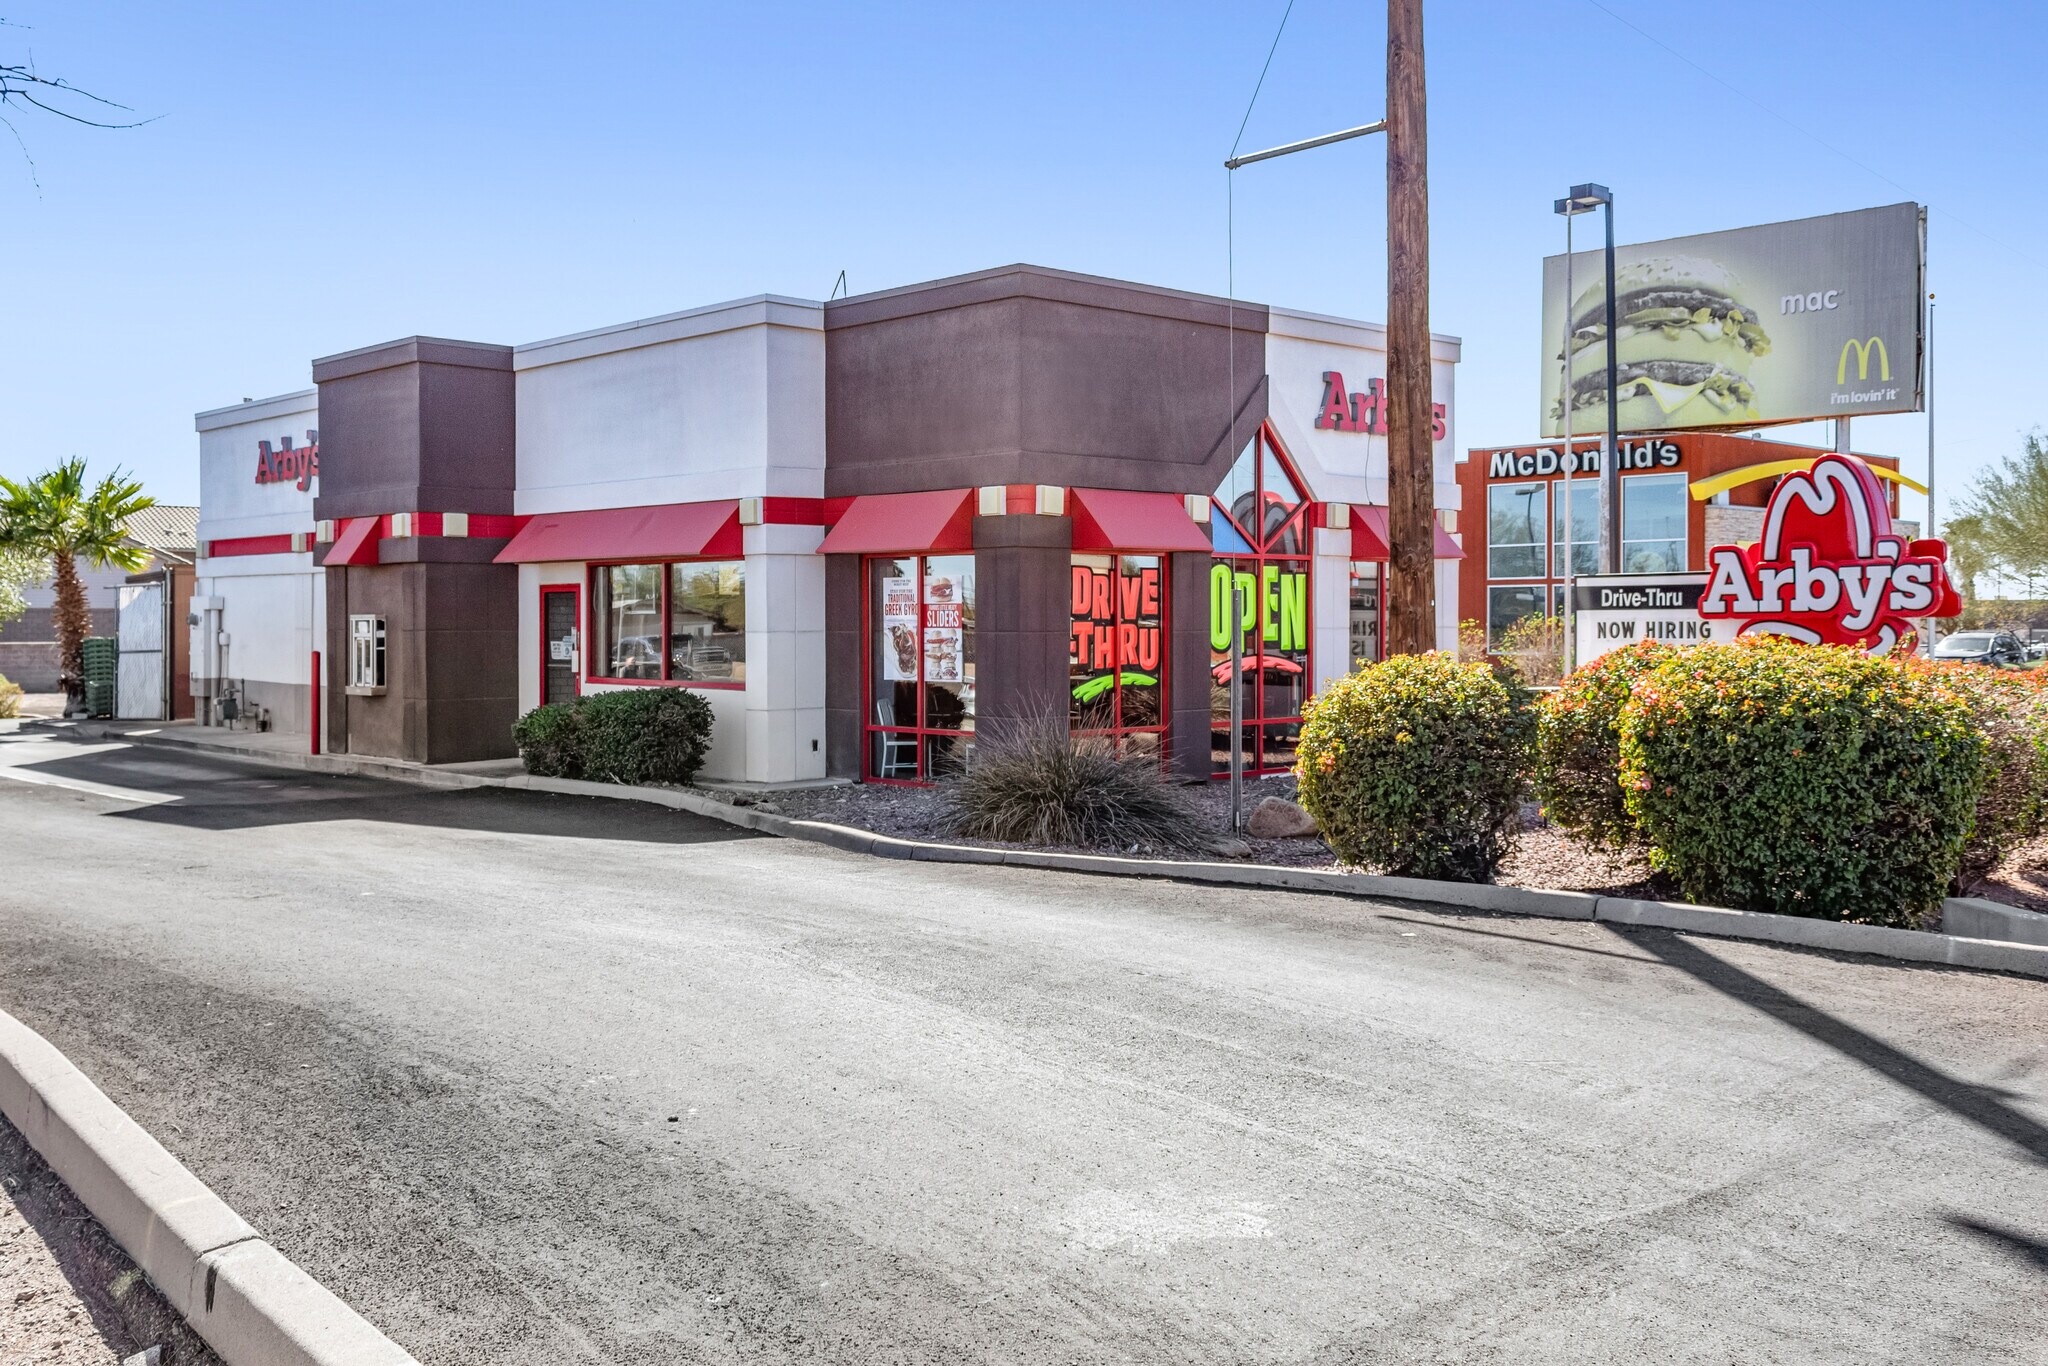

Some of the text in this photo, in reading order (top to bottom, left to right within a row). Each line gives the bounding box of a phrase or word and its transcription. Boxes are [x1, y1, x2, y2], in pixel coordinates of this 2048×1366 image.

[1781, 290, 1838, 315] mac
[1886, 388, 1897, 401] it
[1489, 439, 1680, 478] McDonld's
[1702, 540, 1933, 631] Arby's
[888, 594, 915, 603] TRADITIONAL
[1601, 588, 1683, 607] Drive-Thru
[885, 604, 902, 615] GREEK
[1210, 564, 1307, 653] OPEN
[927, 610, 959, 627] SLIDERS
[1597, 621, 1712, 639] NOW HIRING
